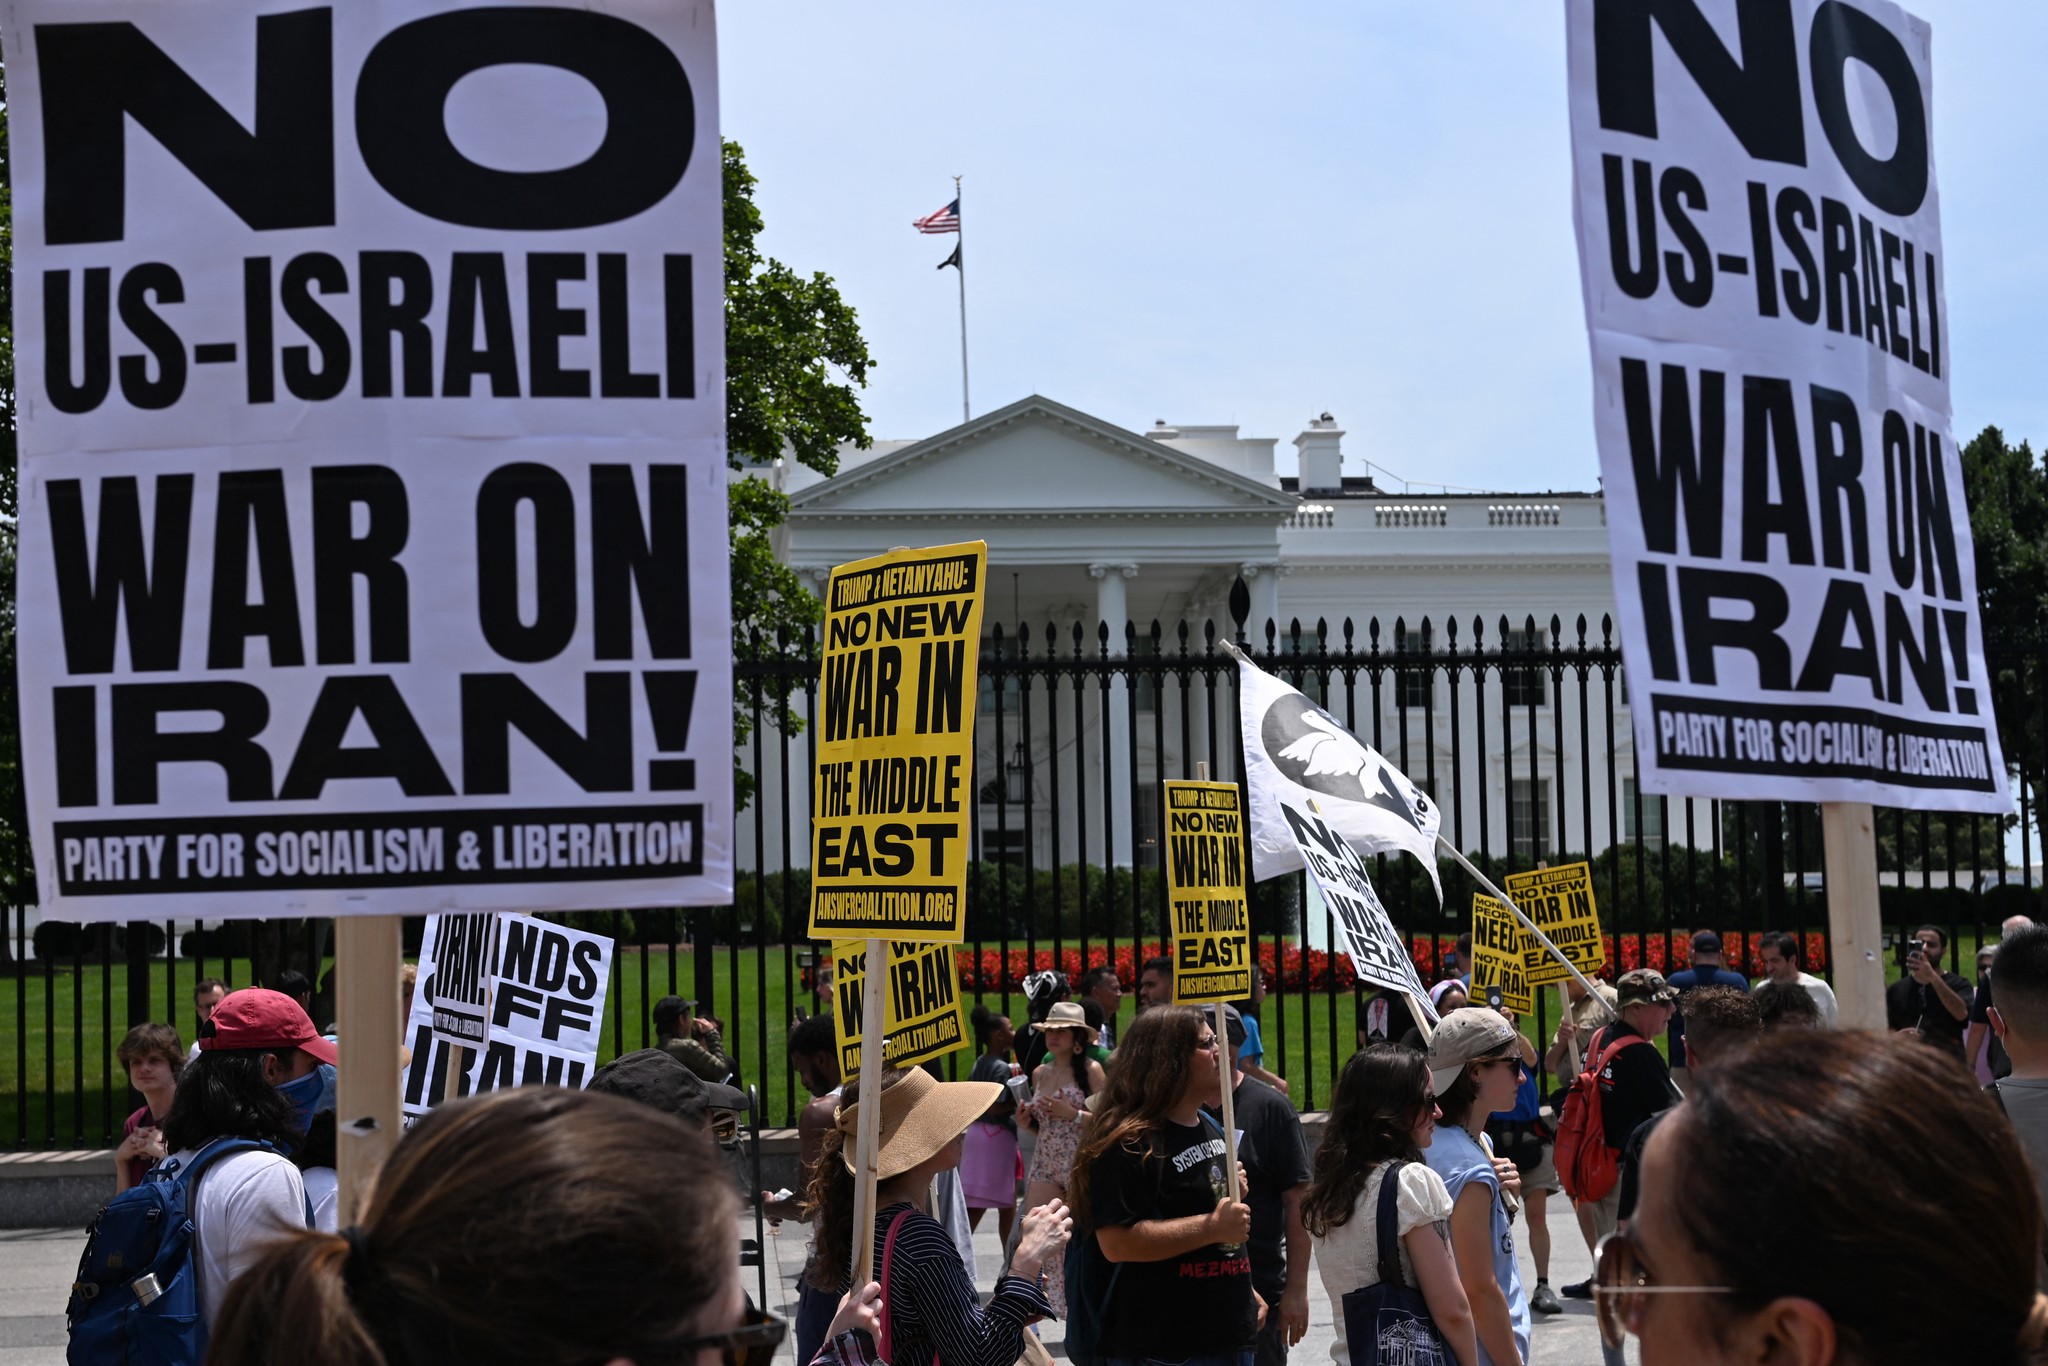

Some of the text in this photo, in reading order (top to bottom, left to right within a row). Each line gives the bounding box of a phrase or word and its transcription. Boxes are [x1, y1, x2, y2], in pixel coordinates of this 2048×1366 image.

[33, 6, 695, 246] NO
[1593, 0, 1929, 217] NO
[1602, 152, 1940, 380] US-ISRAELI
[43, 250, 695, 414] US-ISRAELI
[1620, 356, 1963, 602] WAR ON
[46, 462, 692, 675] WAR ON
[837, 560, 969, 607] TRUMP & NETANYAHU:
[829, 599, 974, 650] NO NEW
[1637, 561, 1979, 716] IRAN!
[825, 640, 965, 742] WAR IN
[53, 670, 698, 807] IRAN!
[1659, 710, 1989, 780] PARTY FOR SOCIALISM & LIBERATION
[820, 755, 961, 818] THE MIDDLE
[1173, 789, 1198, 806] TRUMP
[1200, 792, 1205, 807] &
[1172, 812, 1238, 833] NO NEW
[1280, 802, 1369, 885] NO
[63, 820, 693, 882] PARTY FOR SOCIALISM & LIBERATION
[818, 823, 958, 877] EAST
[1171, 835, 1241, 887] WAR IN
[817, 891, 953, 922] ANSWERCOALITION.ORG
[1174, 899, 1246, 933] THE MIDDLE
[1511, 879, 1586, 901] NO NEW
[1515, 891, 1591, 929] WAR IN
[1179, 936, 1246, 969] EAST
[1474, 952, 1500, 966] NOT
[1523, 942, 1598, 968] EAST
[1544, 922, 1597, 945] MIDDLE
[890, 944, 954, 1023] IRAN
[1500, 969, 1531, 998] IRAN
[1172, 1144, 1206, 1172] SYSTEM
